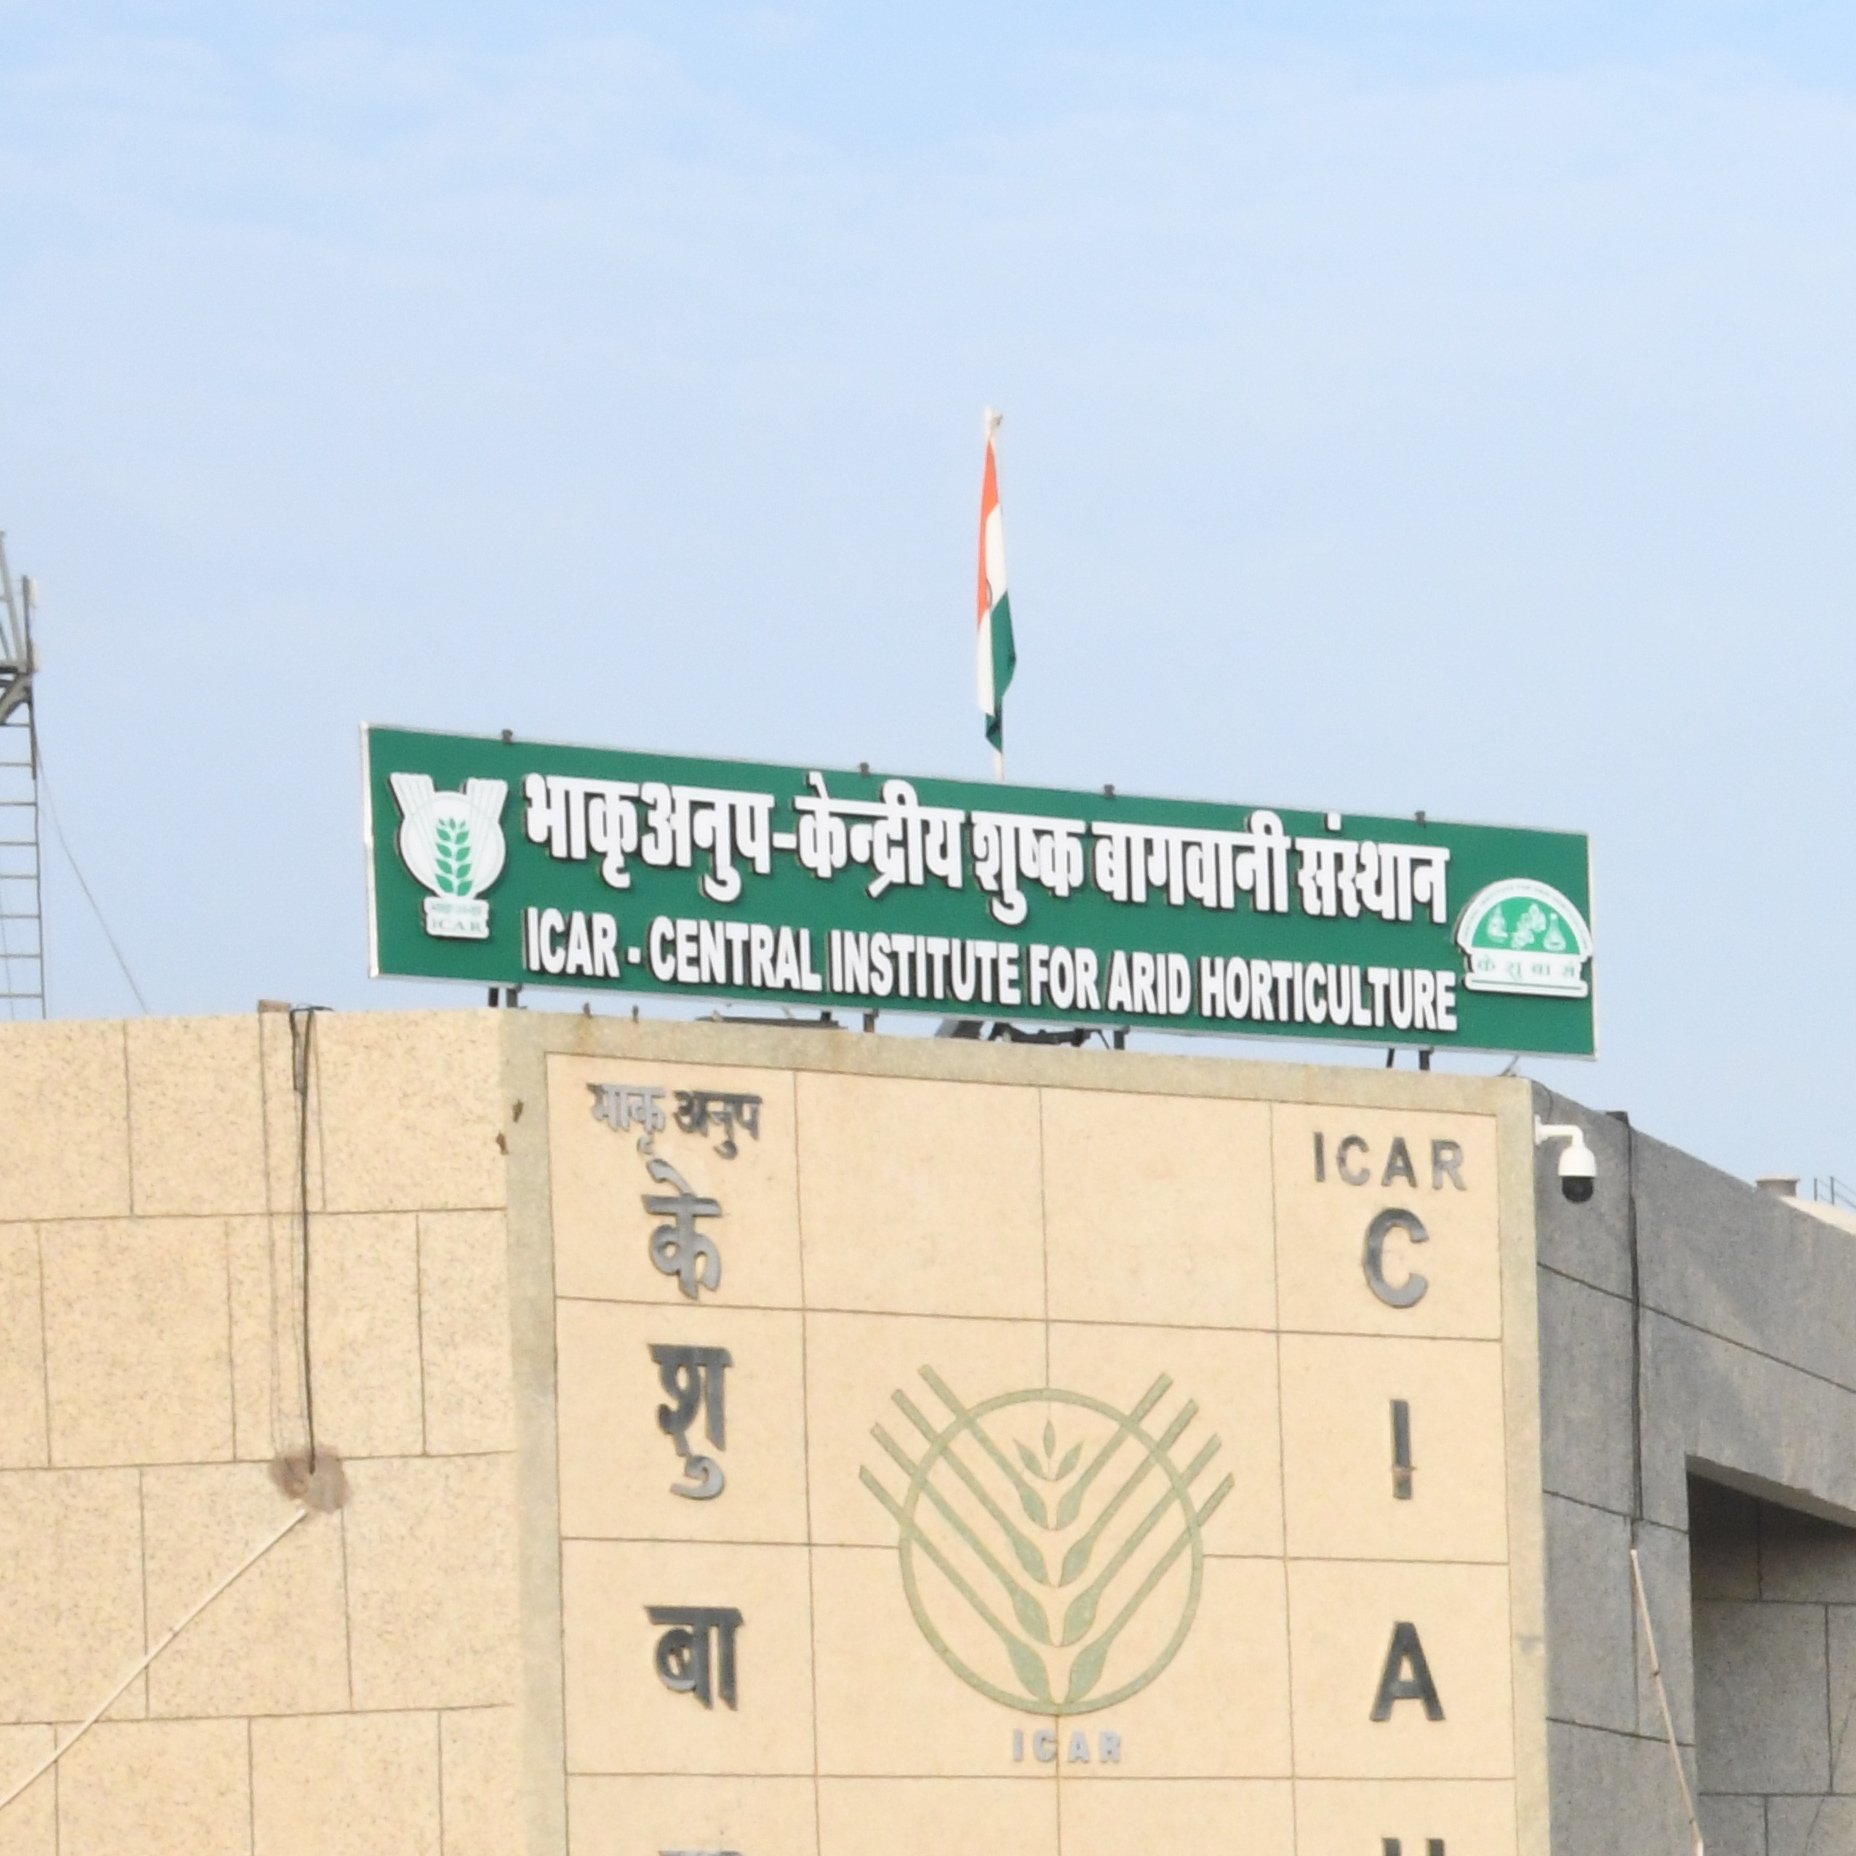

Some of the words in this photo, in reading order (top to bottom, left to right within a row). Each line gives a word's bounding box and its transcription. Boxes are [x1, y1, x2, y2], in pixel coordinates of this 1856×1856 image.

[970, 811, 1086, 926] शुष्क
[1091, 811, 1292, 912] बागवानी
[1295, 809, 1451, 924] संस्थान
[528, 907, 619, 977] ICAR
[650, 916, 823, 991] CENTRAL
[831, 929, 1021, 1004] INSTITUTE
[1030, 944, 1100, 1010] FOR
[1108, 950, 1191, 1014] ARID
[1201, 956, 1458, 1031] HORTICULTURE
[672, 1089, 763, 1160] अनुप
[1312, 1131, 1468, 1192] ICAR
[1012, 1728, 1122, 1763] ICAR
